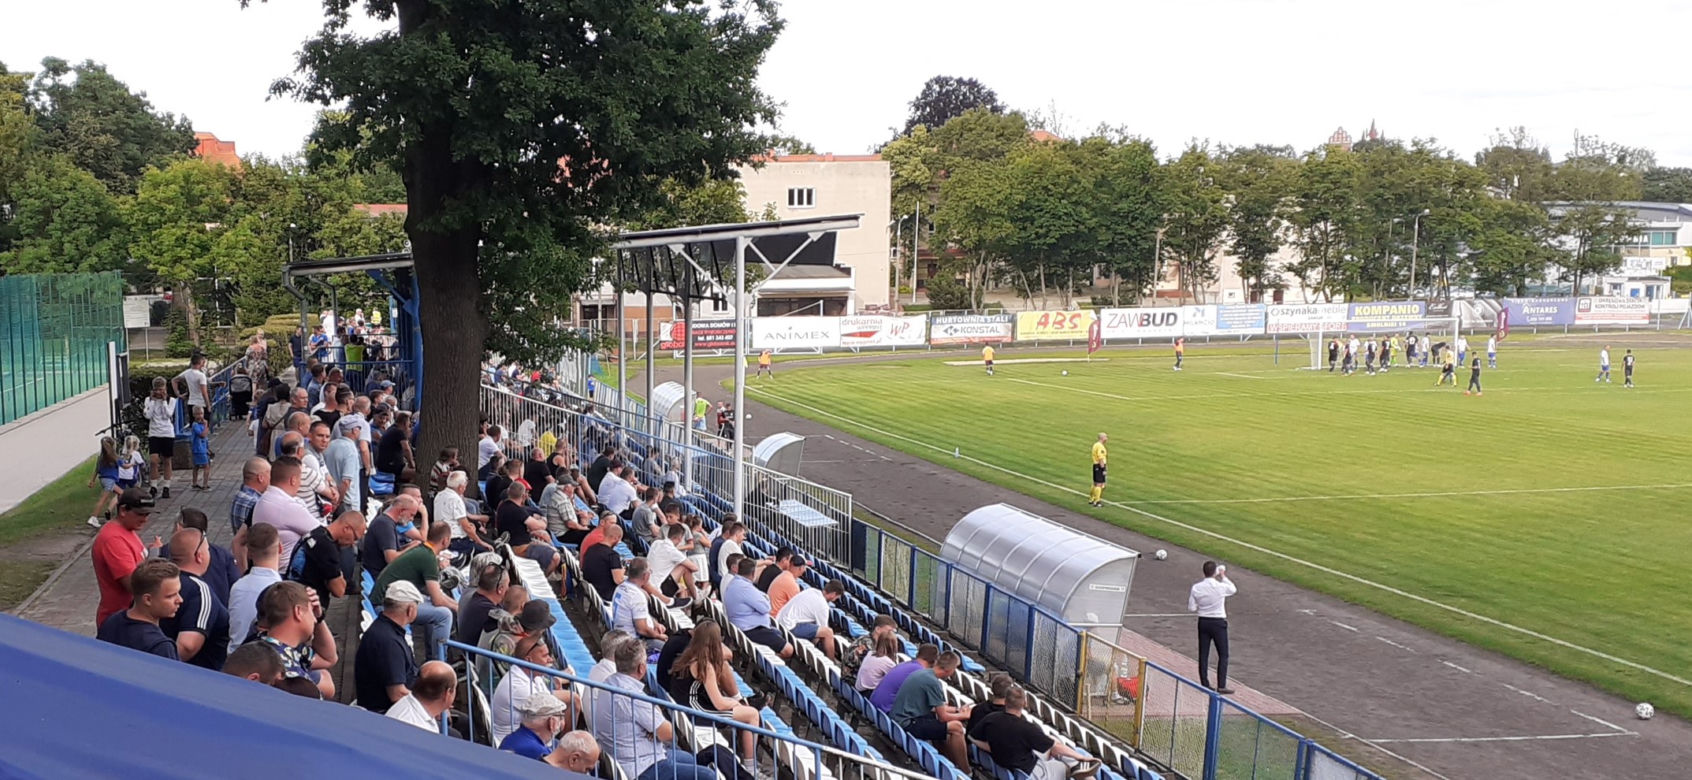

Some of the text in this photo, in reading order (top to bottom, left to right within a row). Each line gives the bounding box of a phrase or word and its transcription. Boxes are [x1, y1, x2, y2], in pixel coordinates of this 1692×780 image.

[1354, 304, 1420, 316] KOMPANIO
[842, 317, 882, 326] drukarnia
[935, 315, 985, 324] HURTOWNIA
[1036, 312, 1082, 330] ABS
[1106, 312, 1178, 329] ZAWBUD
[960, 325, 1001, 334] KONSTAL
